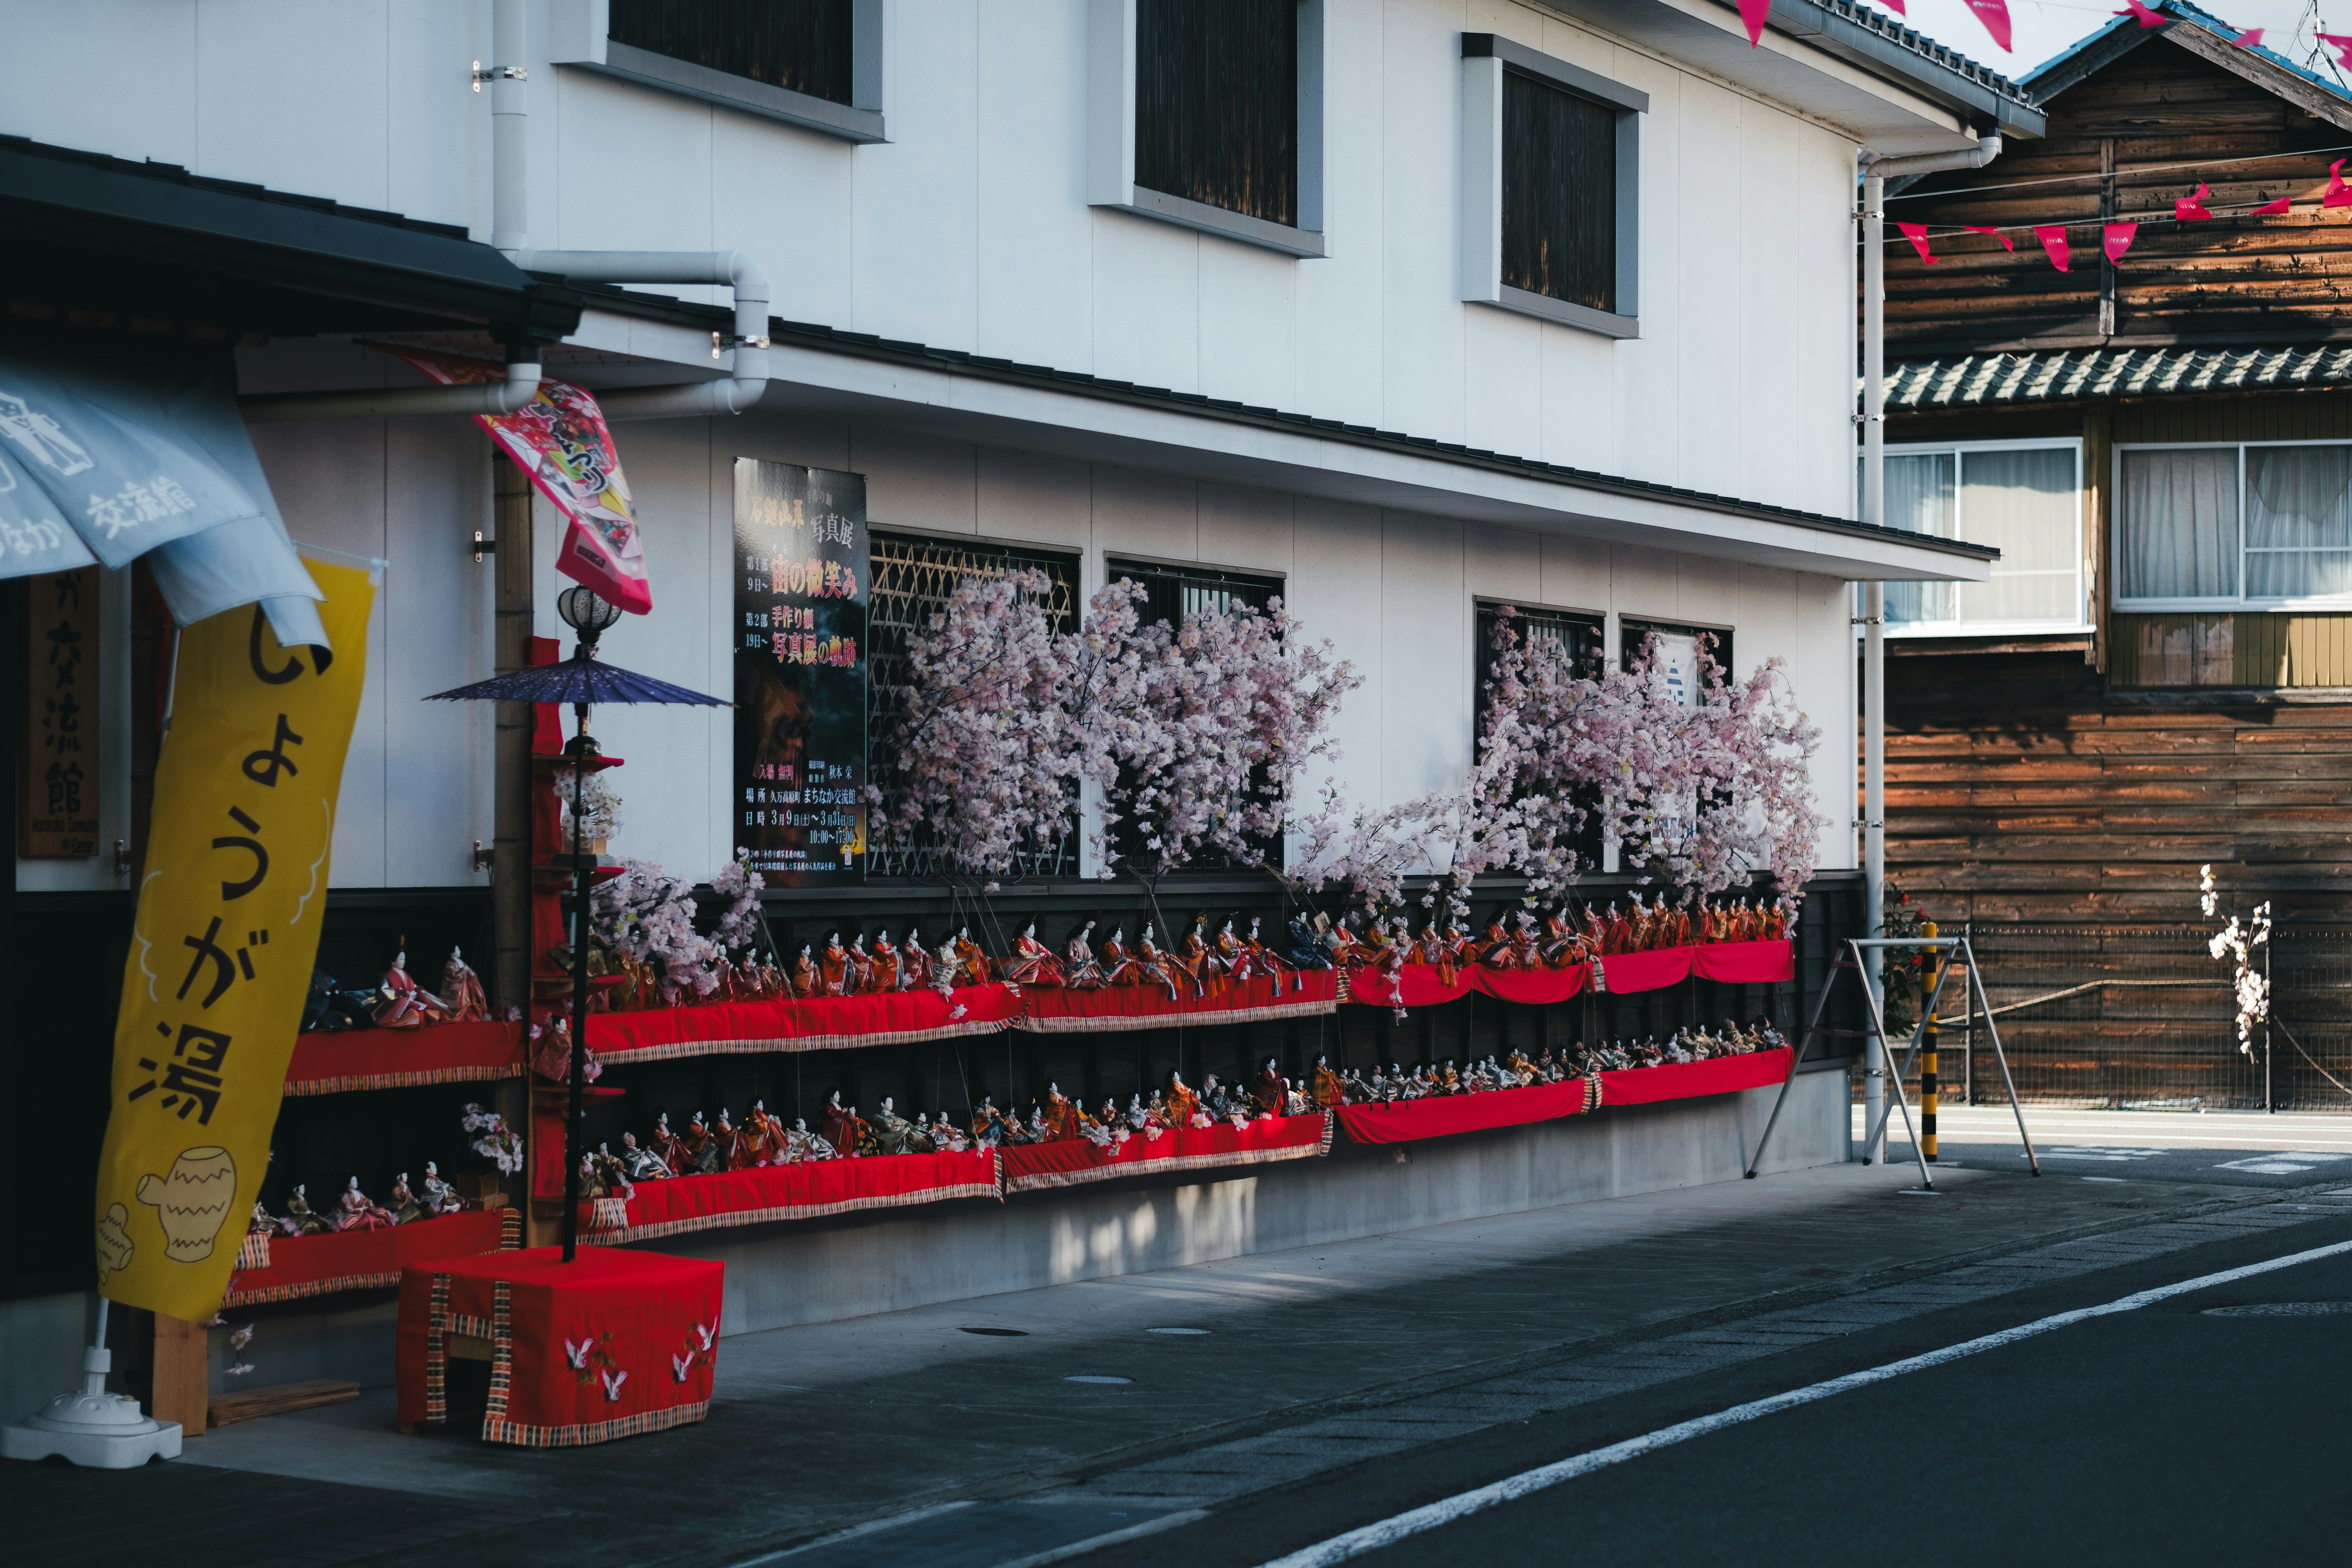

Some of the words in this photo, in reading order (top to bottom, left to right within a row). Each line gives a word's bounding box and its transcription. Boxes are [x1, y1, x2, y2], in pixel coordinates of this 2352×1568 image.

[86, 476, 198, 540] 交流館
[0, 518, 63, 557] なか
[811, 513, 854, 550] 写真展
[746, 556, 769, 571] 第1部
[770, 553, 858, 600] 宙の微笑み
[745, 612, 768, 628] 第2部
[771, 605, 814, 630] 手作り額
[771, 631, 856, 668] 写真展の軌跡
[759, 764, 775, 780] 入場
[778, 764, 794, 780] 無料
[770, 790, 801, 804] 久万高原町
[804, 787, 856, 805] まちなか交流館
